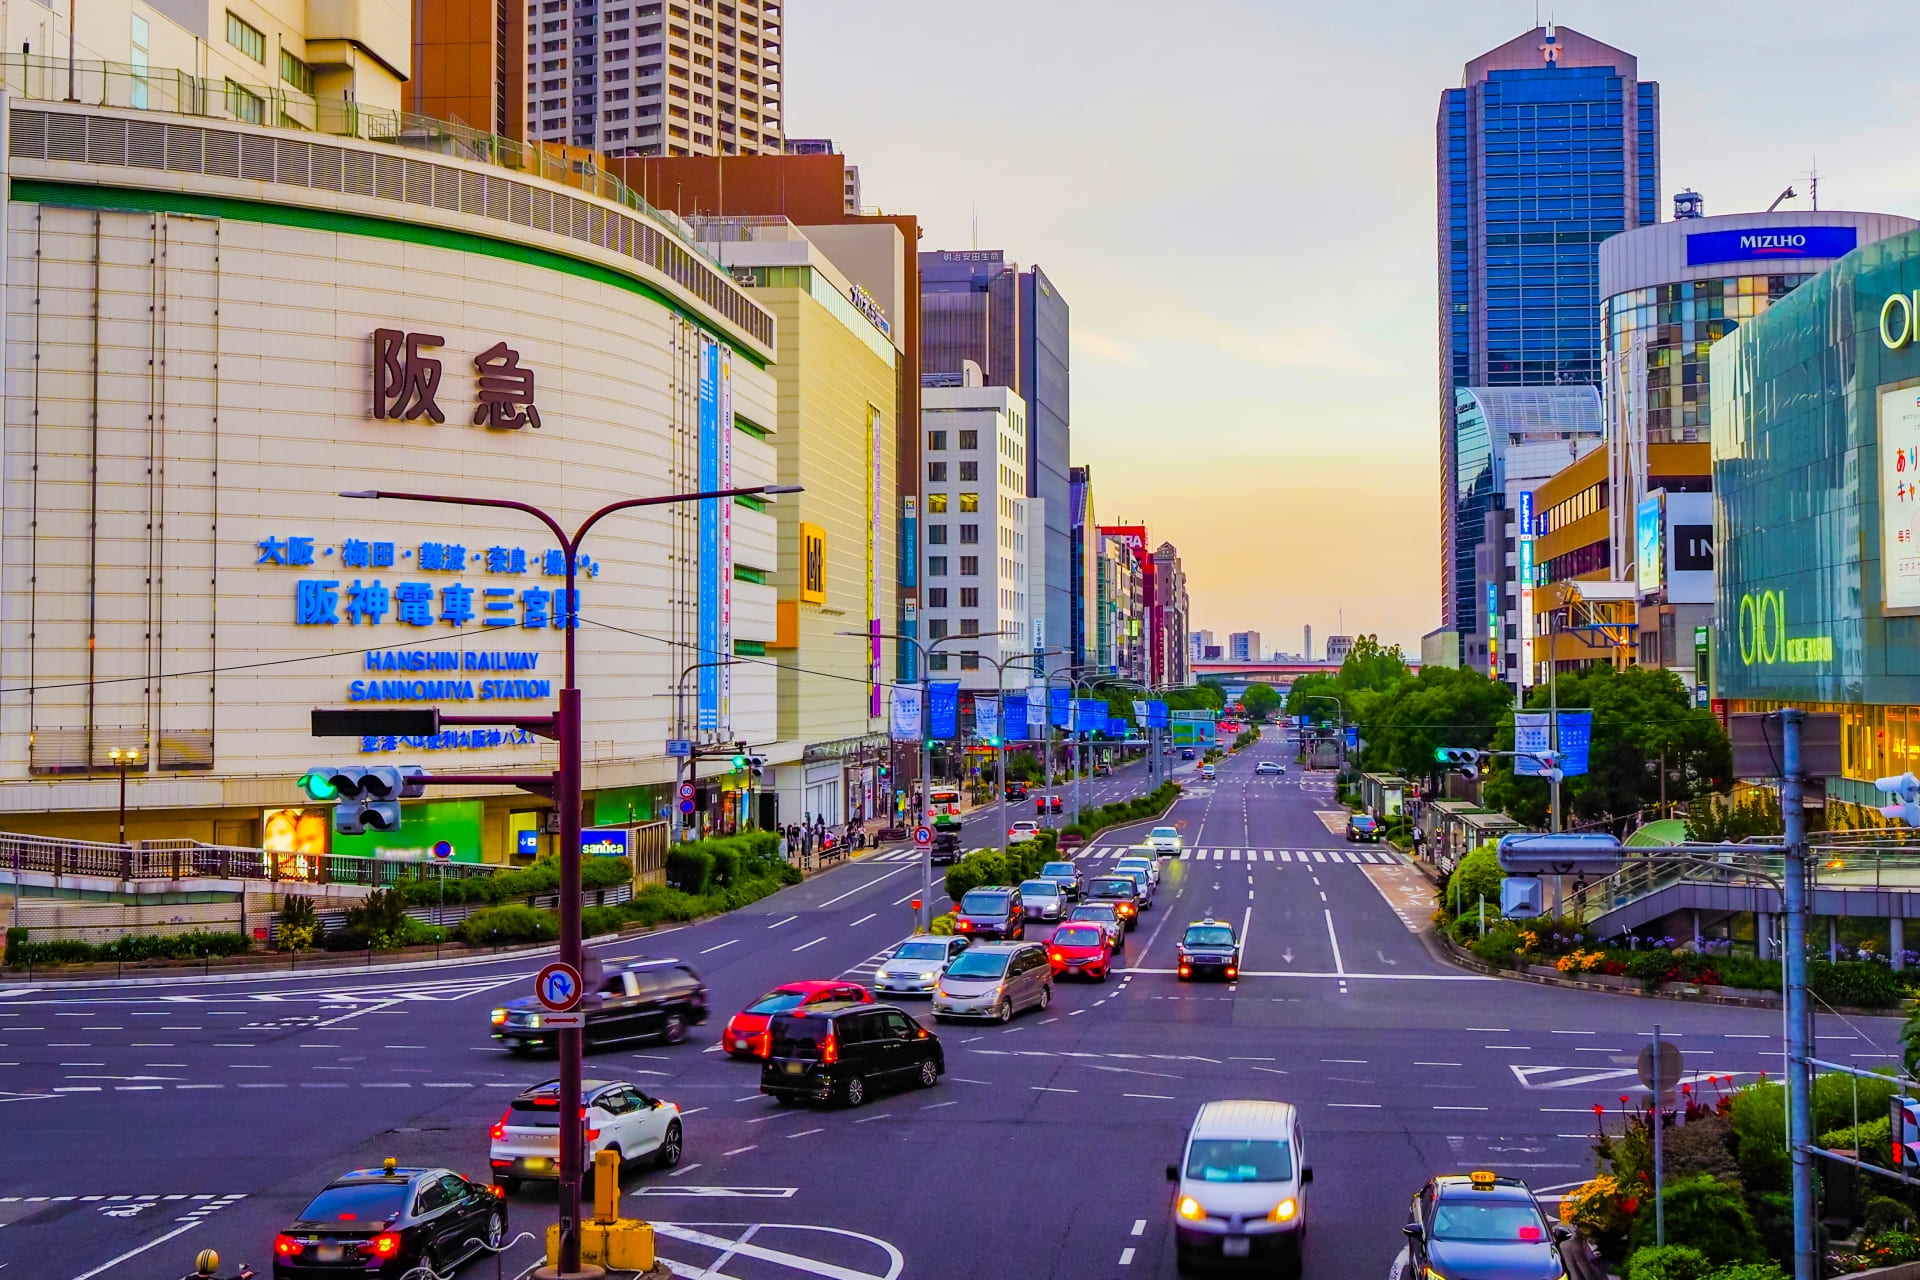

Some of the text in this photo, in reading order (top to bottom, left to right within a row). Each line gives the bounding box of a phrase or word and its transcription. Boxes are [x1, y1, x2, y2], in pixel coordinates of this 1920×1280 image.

[1741, 234, 1805, 248] MIZUHO
[370, 328, 541, 431] 阪急
[297, 579, 581, 630] 阪神電車三宮駅
[366, 651, 540, 671] HANSHIN RAILWAY
[350, 680, 551, 701] SANNOMIYA STATION
